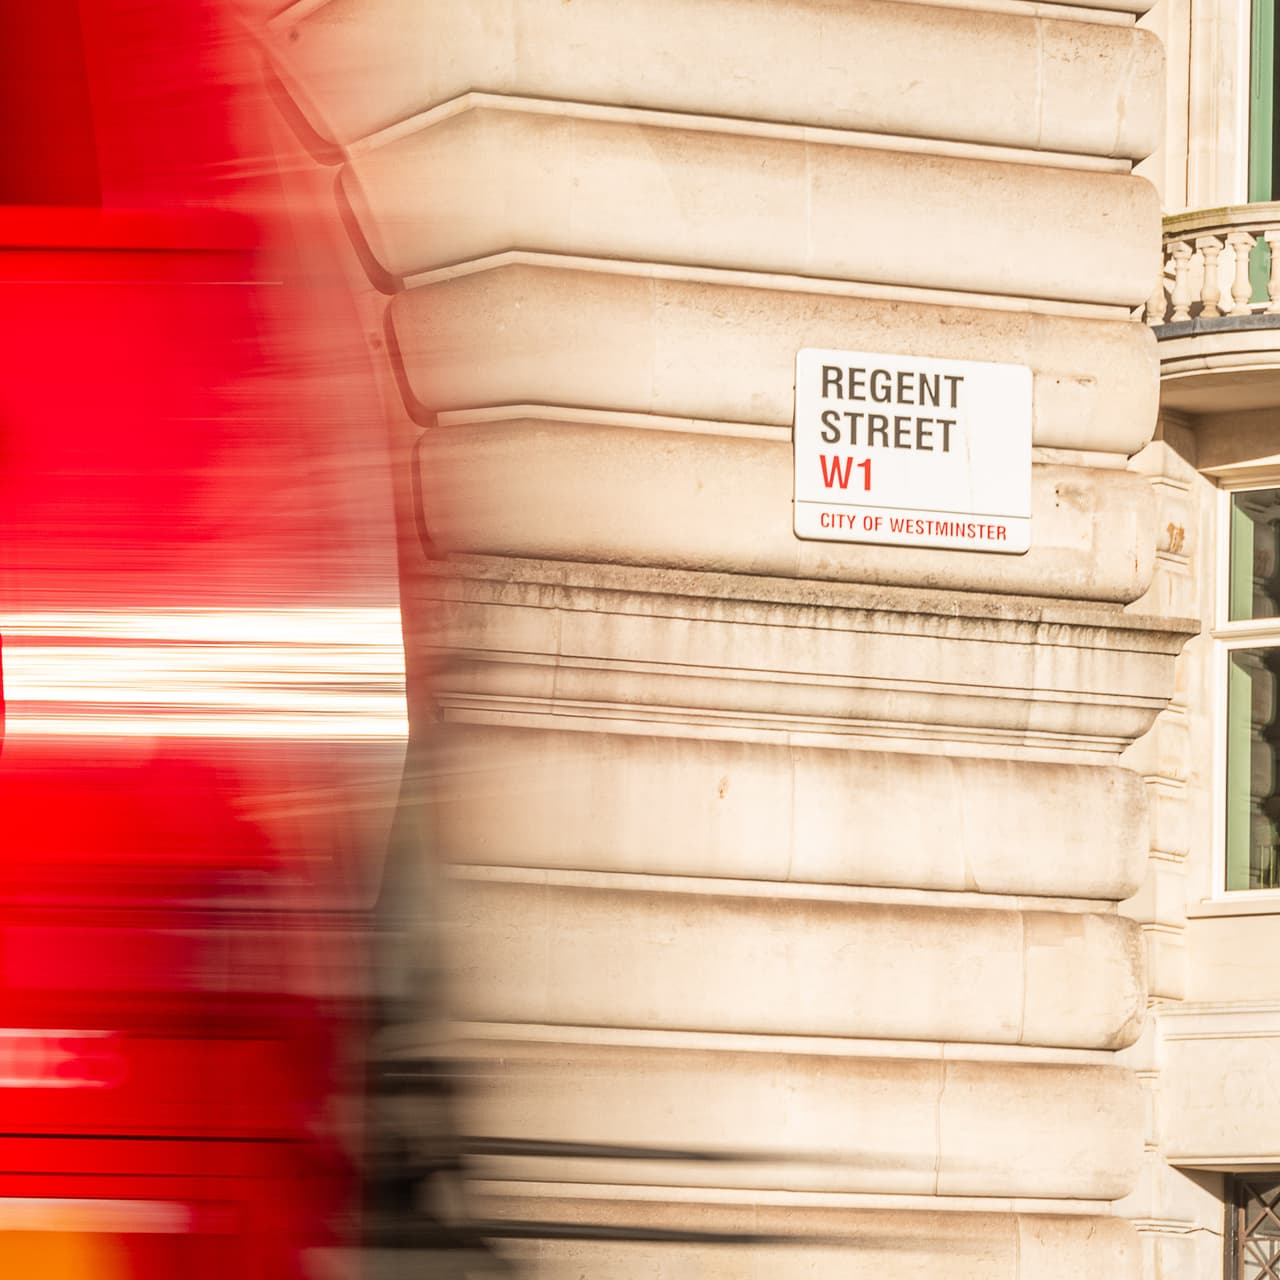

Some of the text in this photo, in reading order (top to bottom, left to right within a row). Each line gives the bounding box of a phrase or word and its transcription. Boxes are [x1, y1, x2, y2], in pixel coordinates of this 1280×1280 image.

[820, 365, 965, 409] REGENT
[820, 409, 957, 453] STREET
[819, 454, 872, 491] W1
[820, 512, 1007, 541] CITY OF WESTMINSTER
